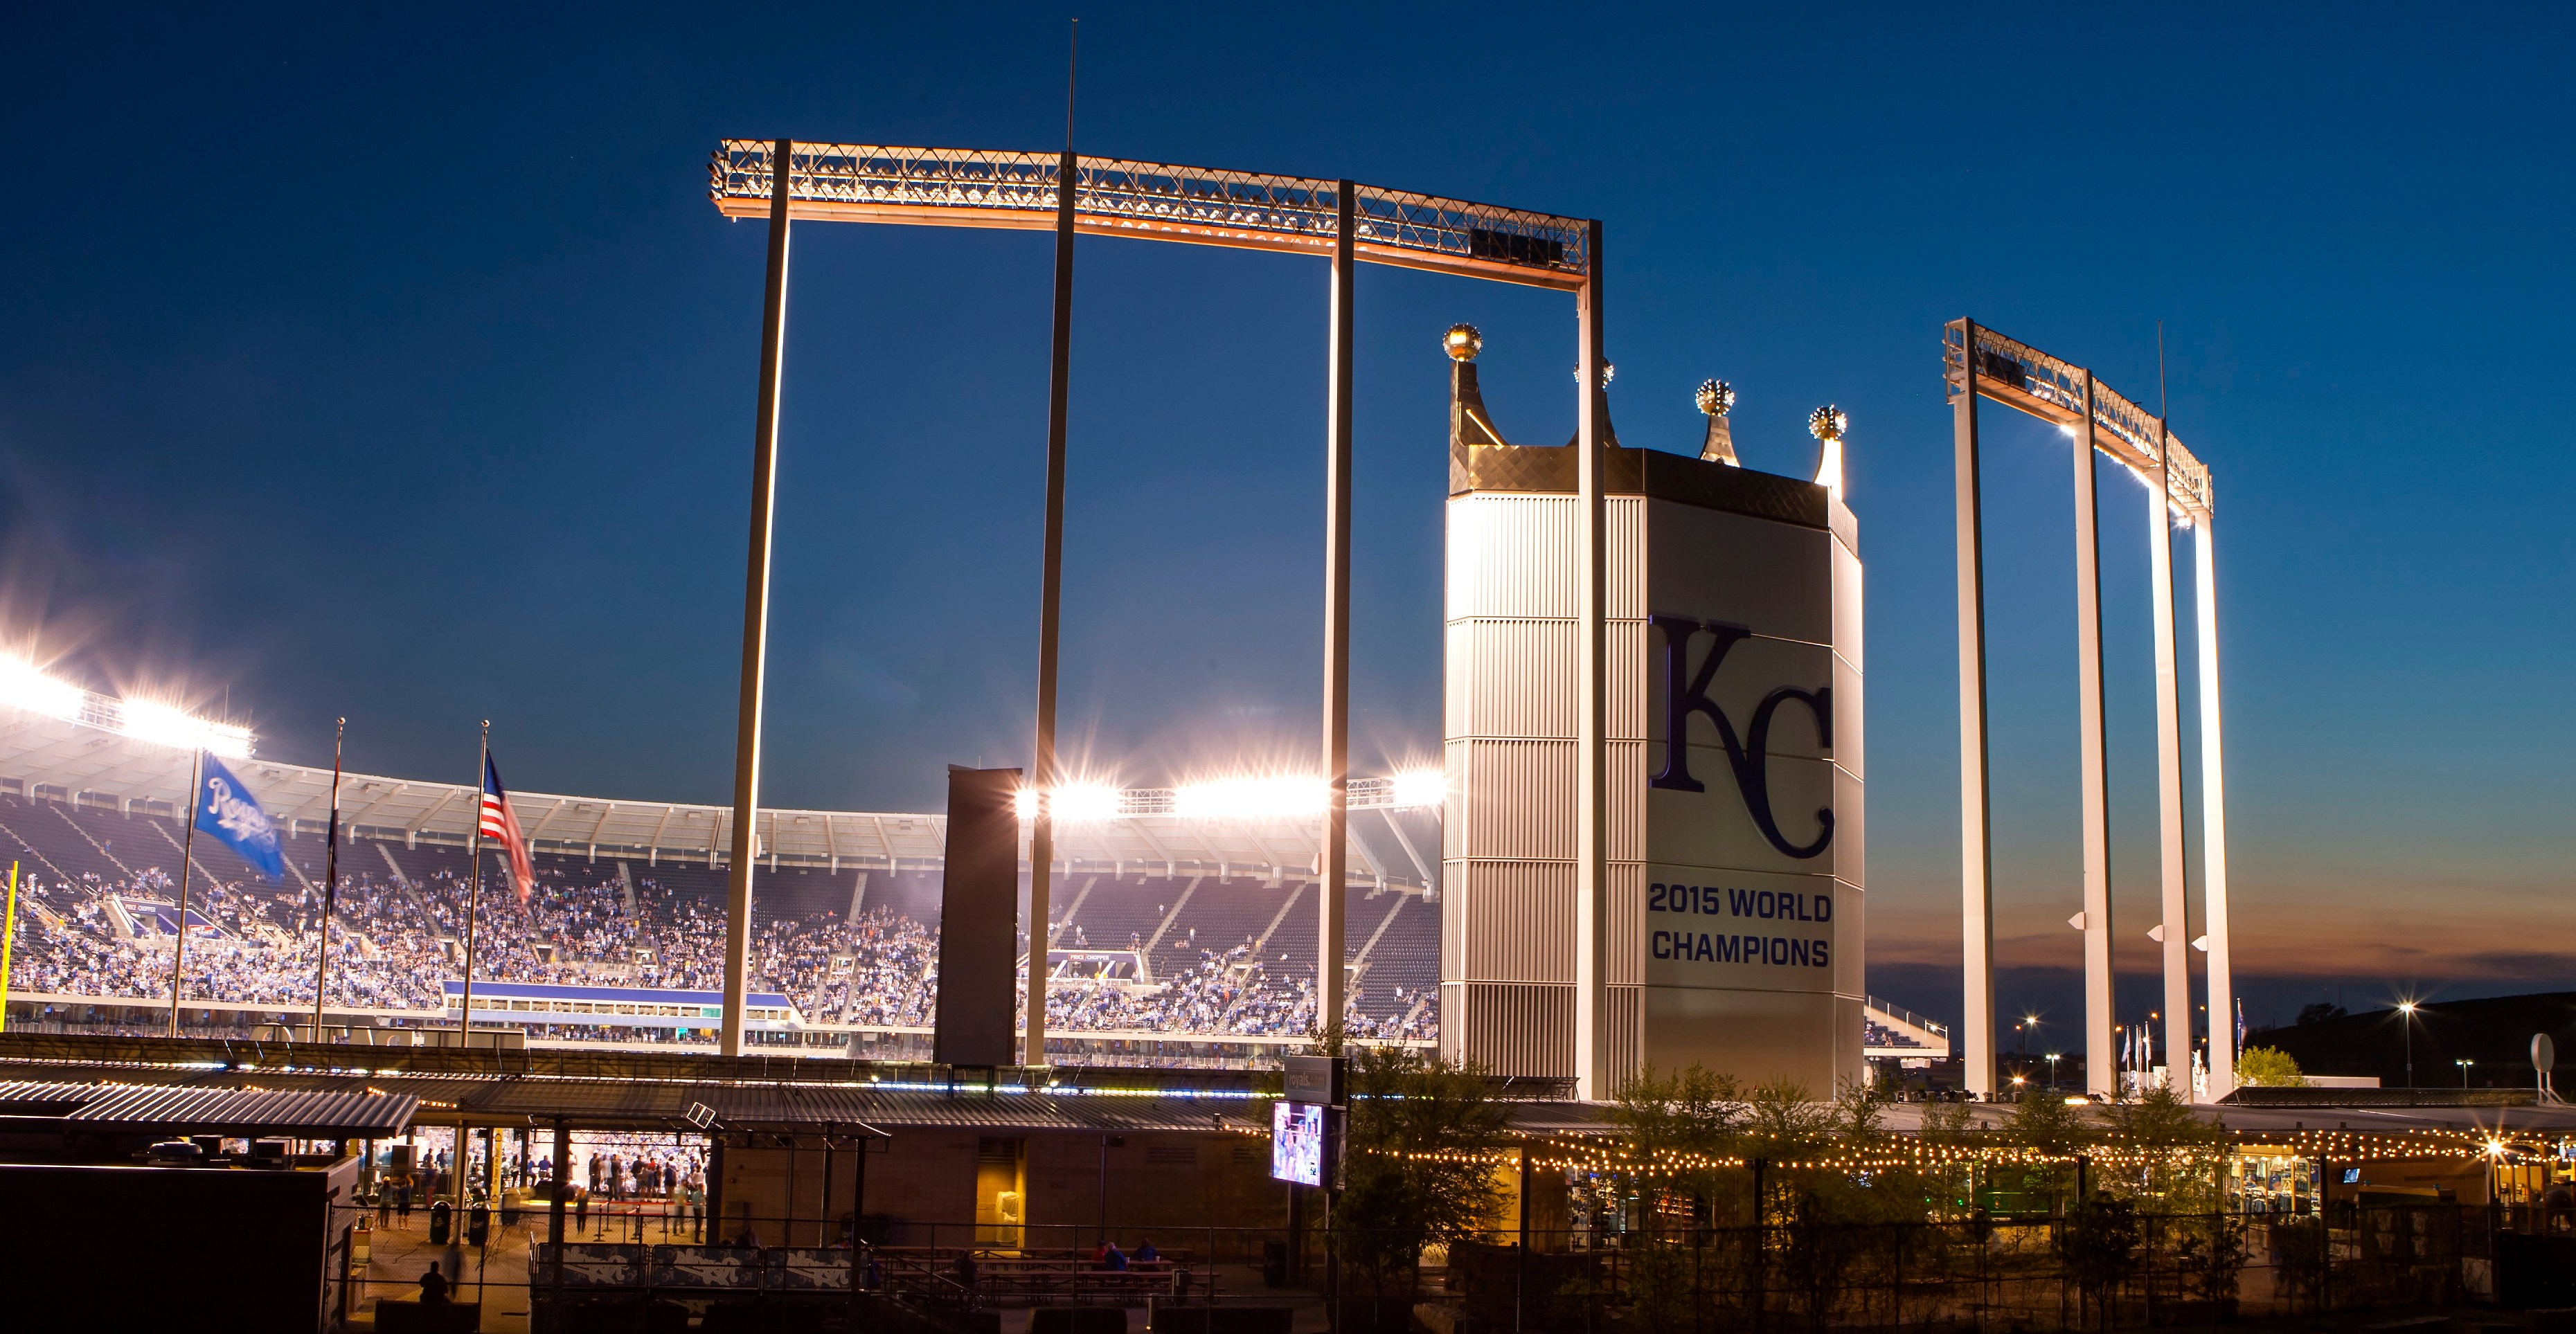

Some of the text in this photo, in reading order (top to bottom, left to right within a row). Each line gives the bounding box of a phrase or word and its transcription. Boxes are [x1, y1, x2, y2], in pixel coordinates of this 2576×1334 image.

[1649, 614, 1834, 859] KC
[1649, 883, 1832, 922] 2015 WORLD
[1652, 930, 1829, 968] CHAMPIONS
[1289, 1071, 1325, 1088] royals.com
